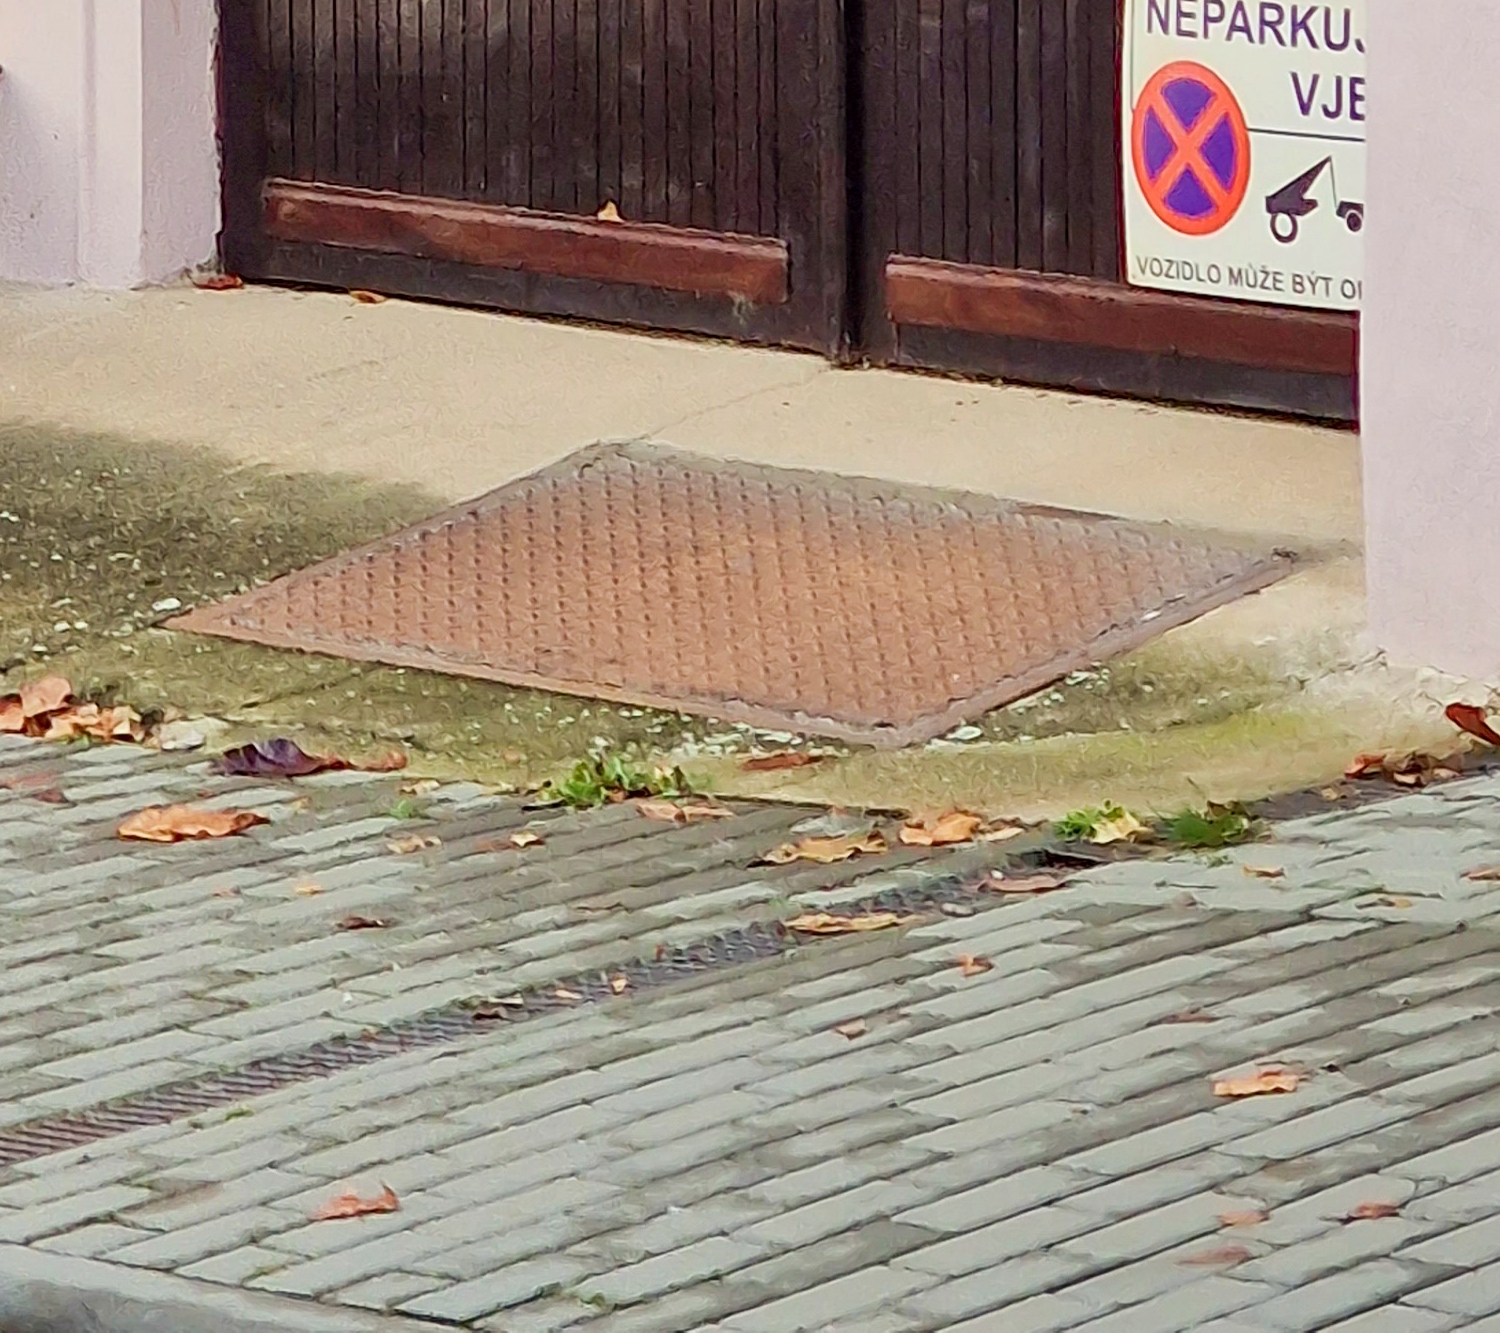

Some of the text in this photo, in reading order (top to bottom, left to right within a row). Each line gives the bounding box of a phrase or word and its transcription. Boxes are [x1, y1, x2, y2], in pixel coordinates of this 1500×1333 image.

[1136, 255, 1363, 301] VOZIDLO MŮŽE BÝT O
